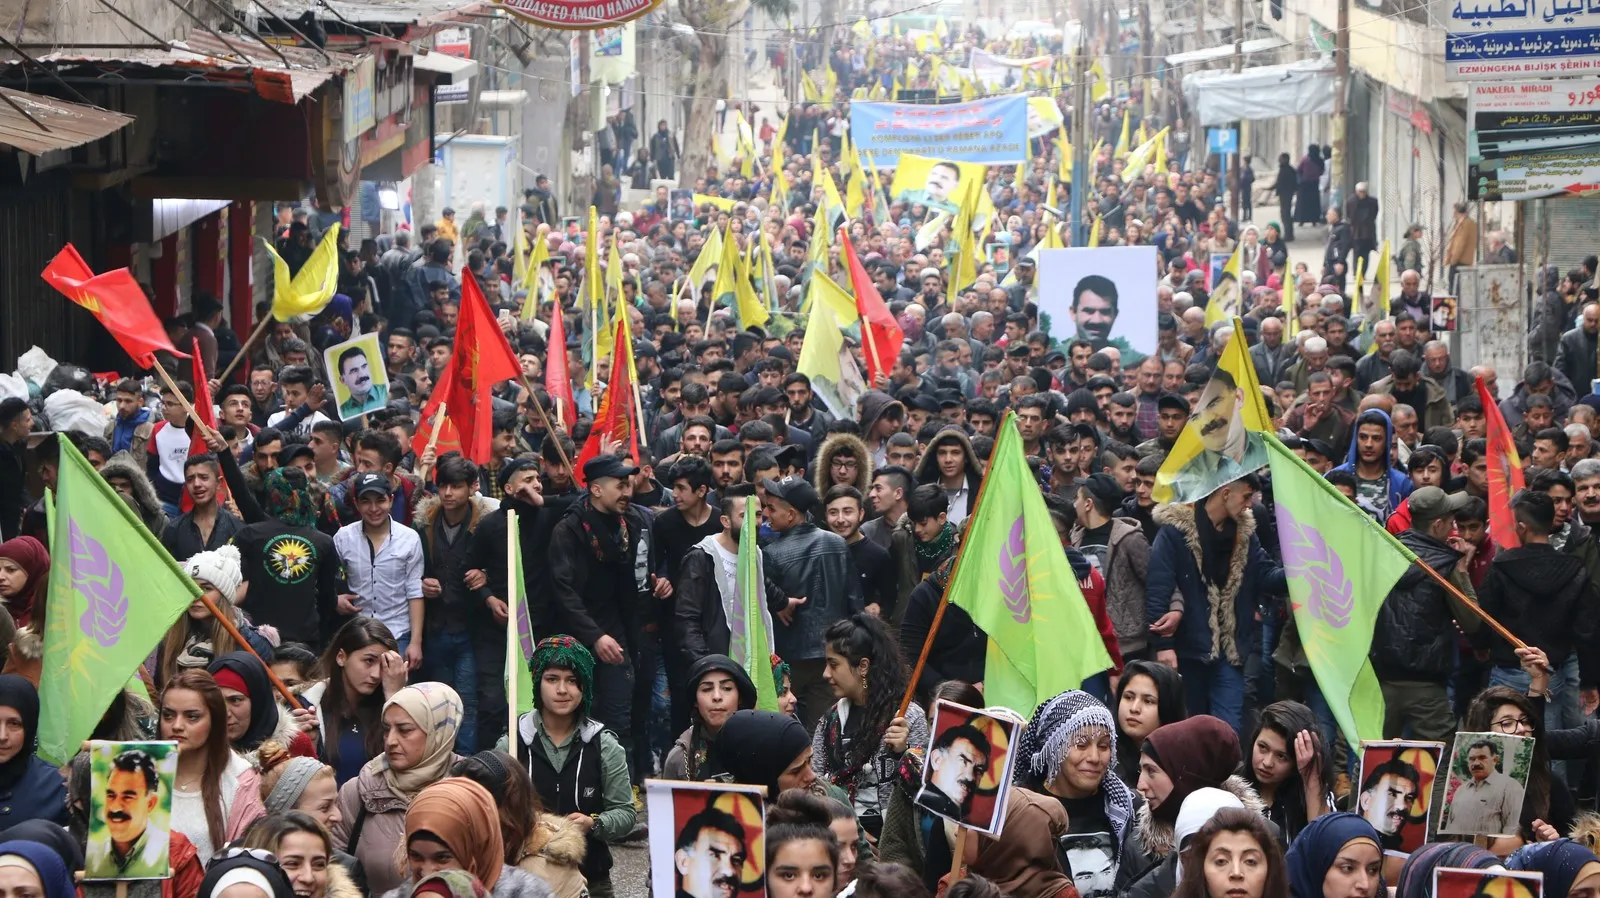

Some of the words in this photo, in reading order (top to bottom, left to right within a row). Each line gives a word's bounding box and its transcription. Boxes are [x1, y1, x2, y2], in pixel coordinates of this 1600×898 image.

[570, 6, 604, 20] AMOO
[1521, 35, 1553, 54] جرثومية
[1560, 35, 1582, 52] دموية
[1475, 85, 1515, 95] AVAKERA
[1218, 130, 1230, 147] P
